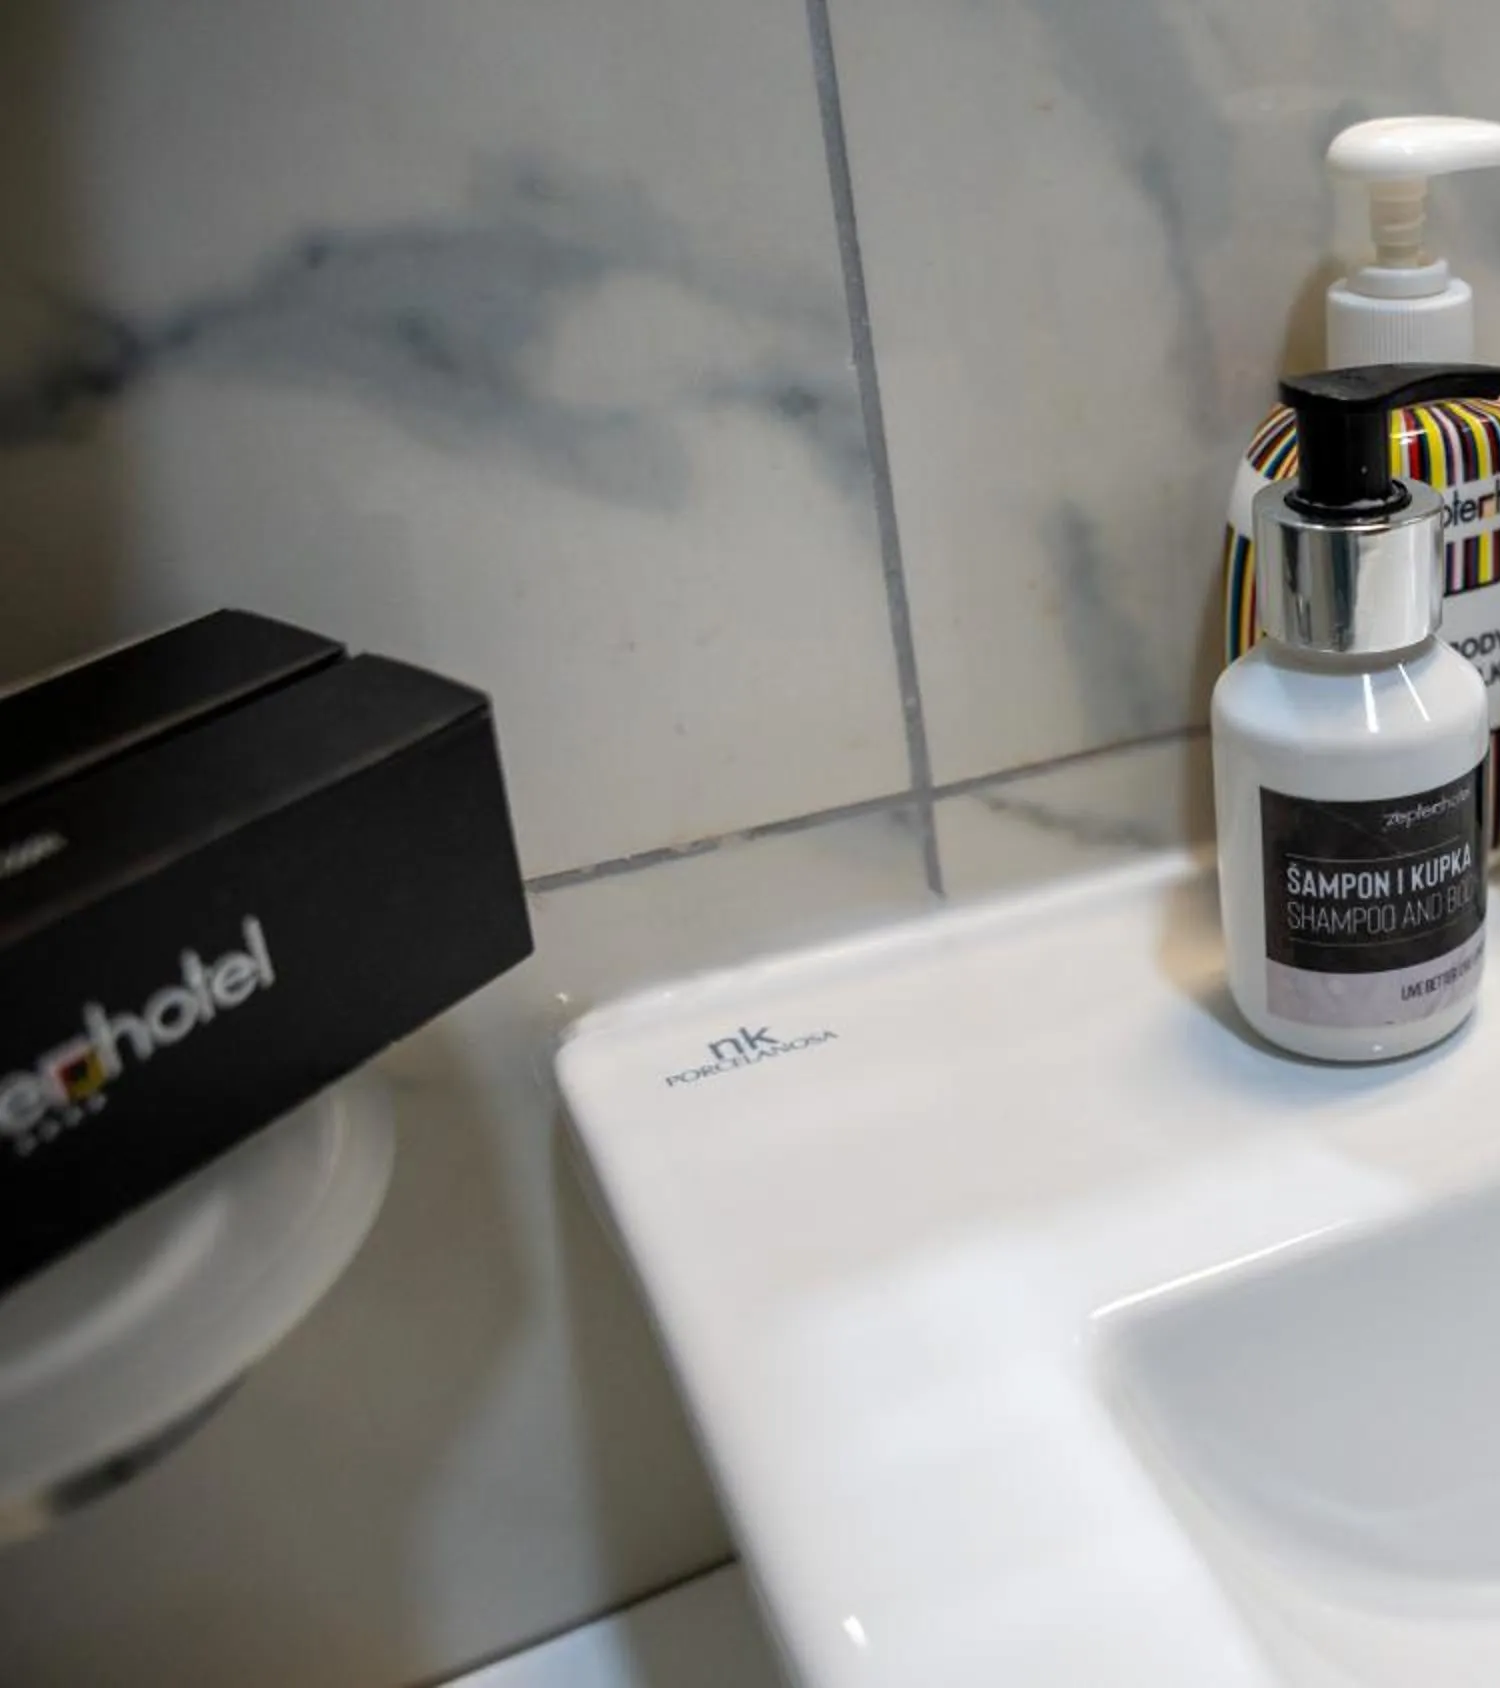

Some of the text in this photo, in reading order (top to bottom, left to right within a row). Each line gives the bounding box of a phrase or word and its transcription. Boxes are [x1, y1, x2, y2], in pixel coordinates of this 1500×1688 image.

[1287, 843, 1472, 900] ŠAMPON I KUPKA
[1287, 901, 1397, 935] SHAMPOO
[1402, 893, 1443, 928] AND
[0, 913, 276, 1134] erhotel
[708, 1026, 779, 1061] nk
[665, 1030, 839, 1087] PORCELANOSA
